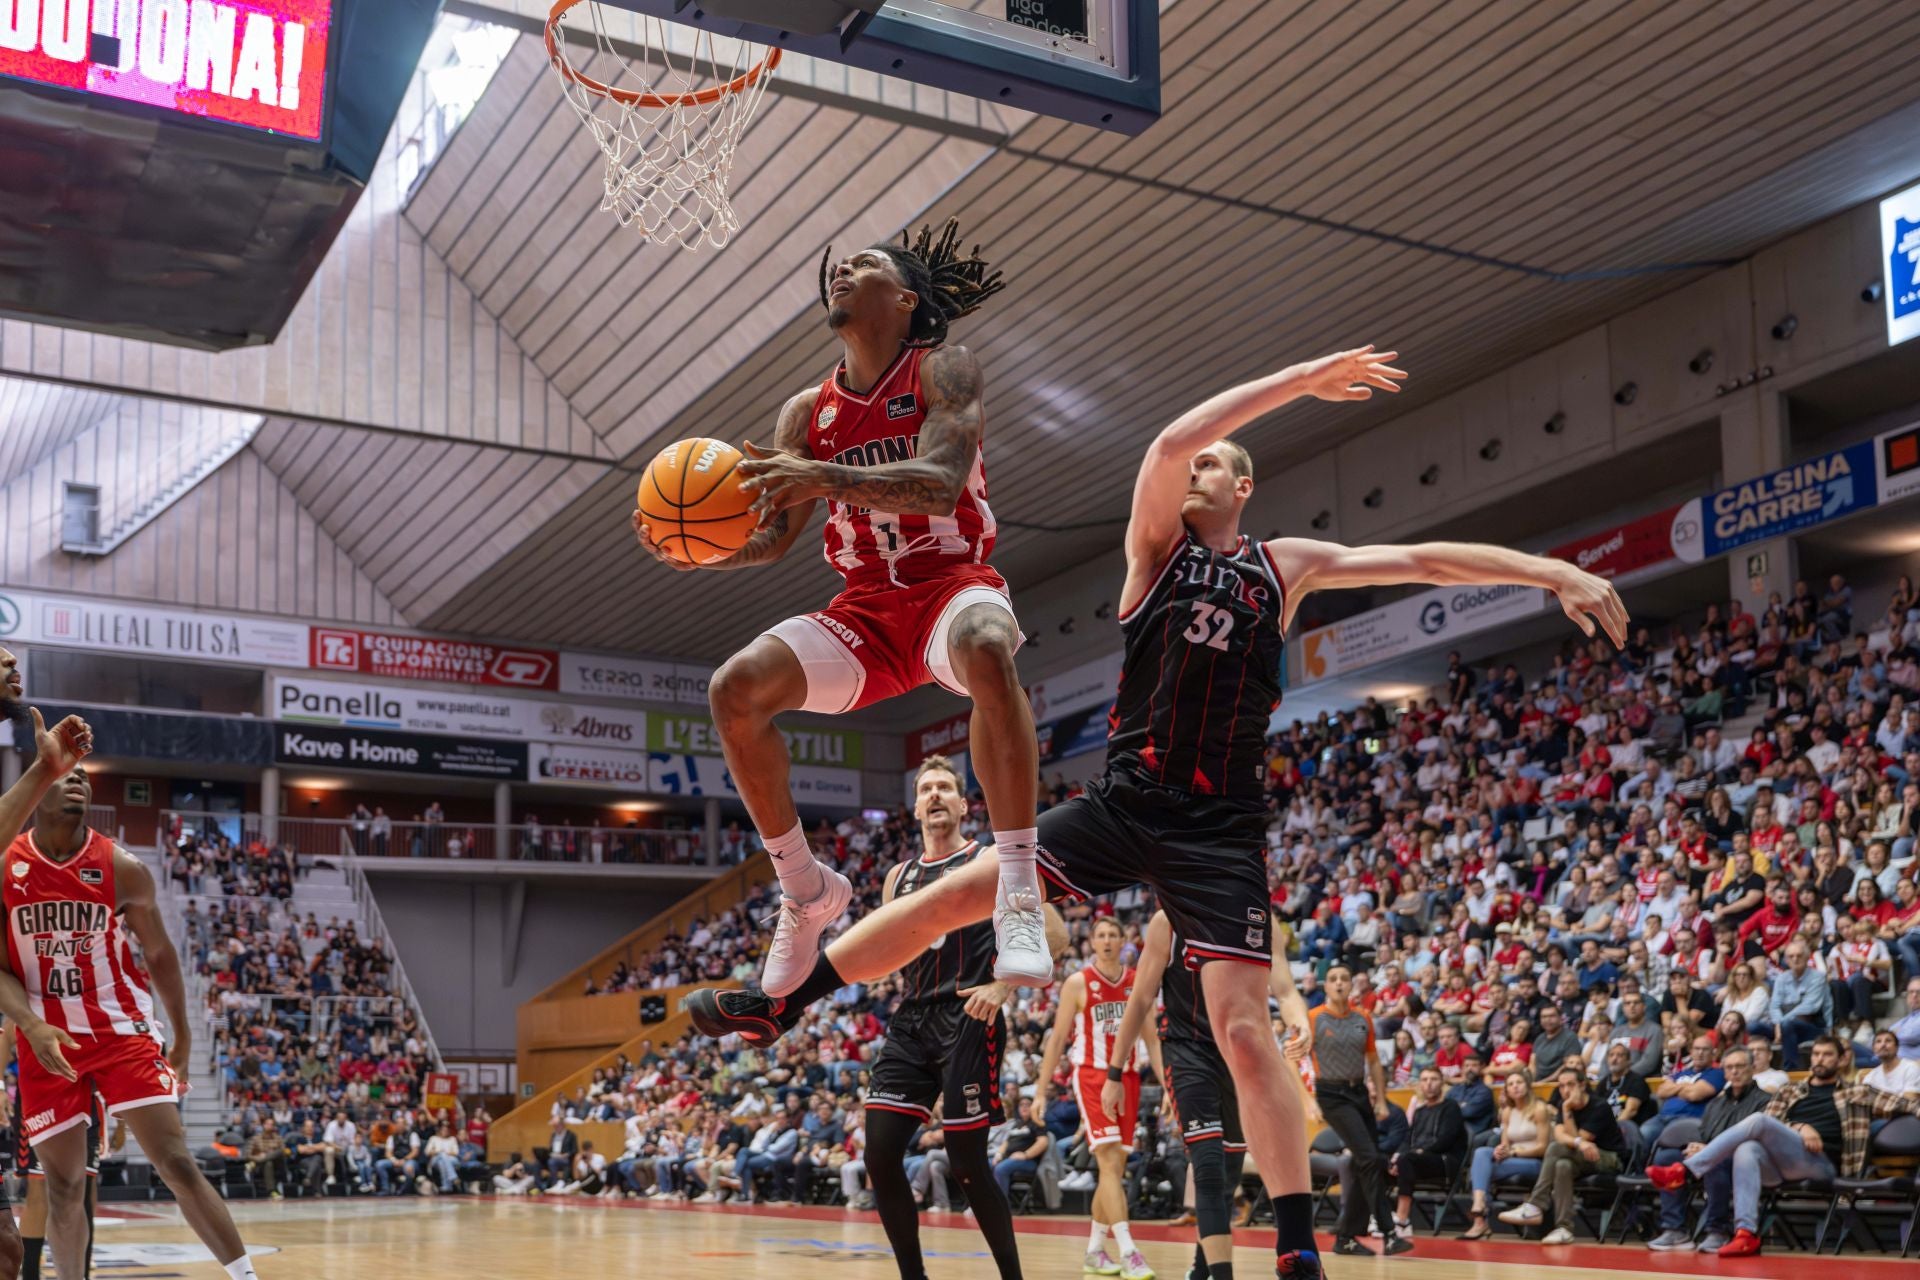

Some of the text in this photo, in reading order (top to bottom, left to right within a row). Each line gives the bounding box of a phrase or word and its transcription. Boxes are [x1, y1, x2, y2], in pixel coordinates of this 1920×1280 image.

[1713, 453, 1850, 516] CALSINA
[878, 522, 897, 552] 1
[84, 611, 153, 648] LLEAL
[814, 612, 865, 650] YOSOY
[1183, 601, 1234, 652] 32
[363, 634, 493, 661] EQUIPACIONS
[371, 652, 486, 673] ESPORTIVES
[281, 685, 401, 719] Panella
[571, 715, 634, 742] Abras
[283, 732, 419, 765] Kave Home
[18, 901, 107, 936] GIRONA
[49, 966, 83, 998] 46
